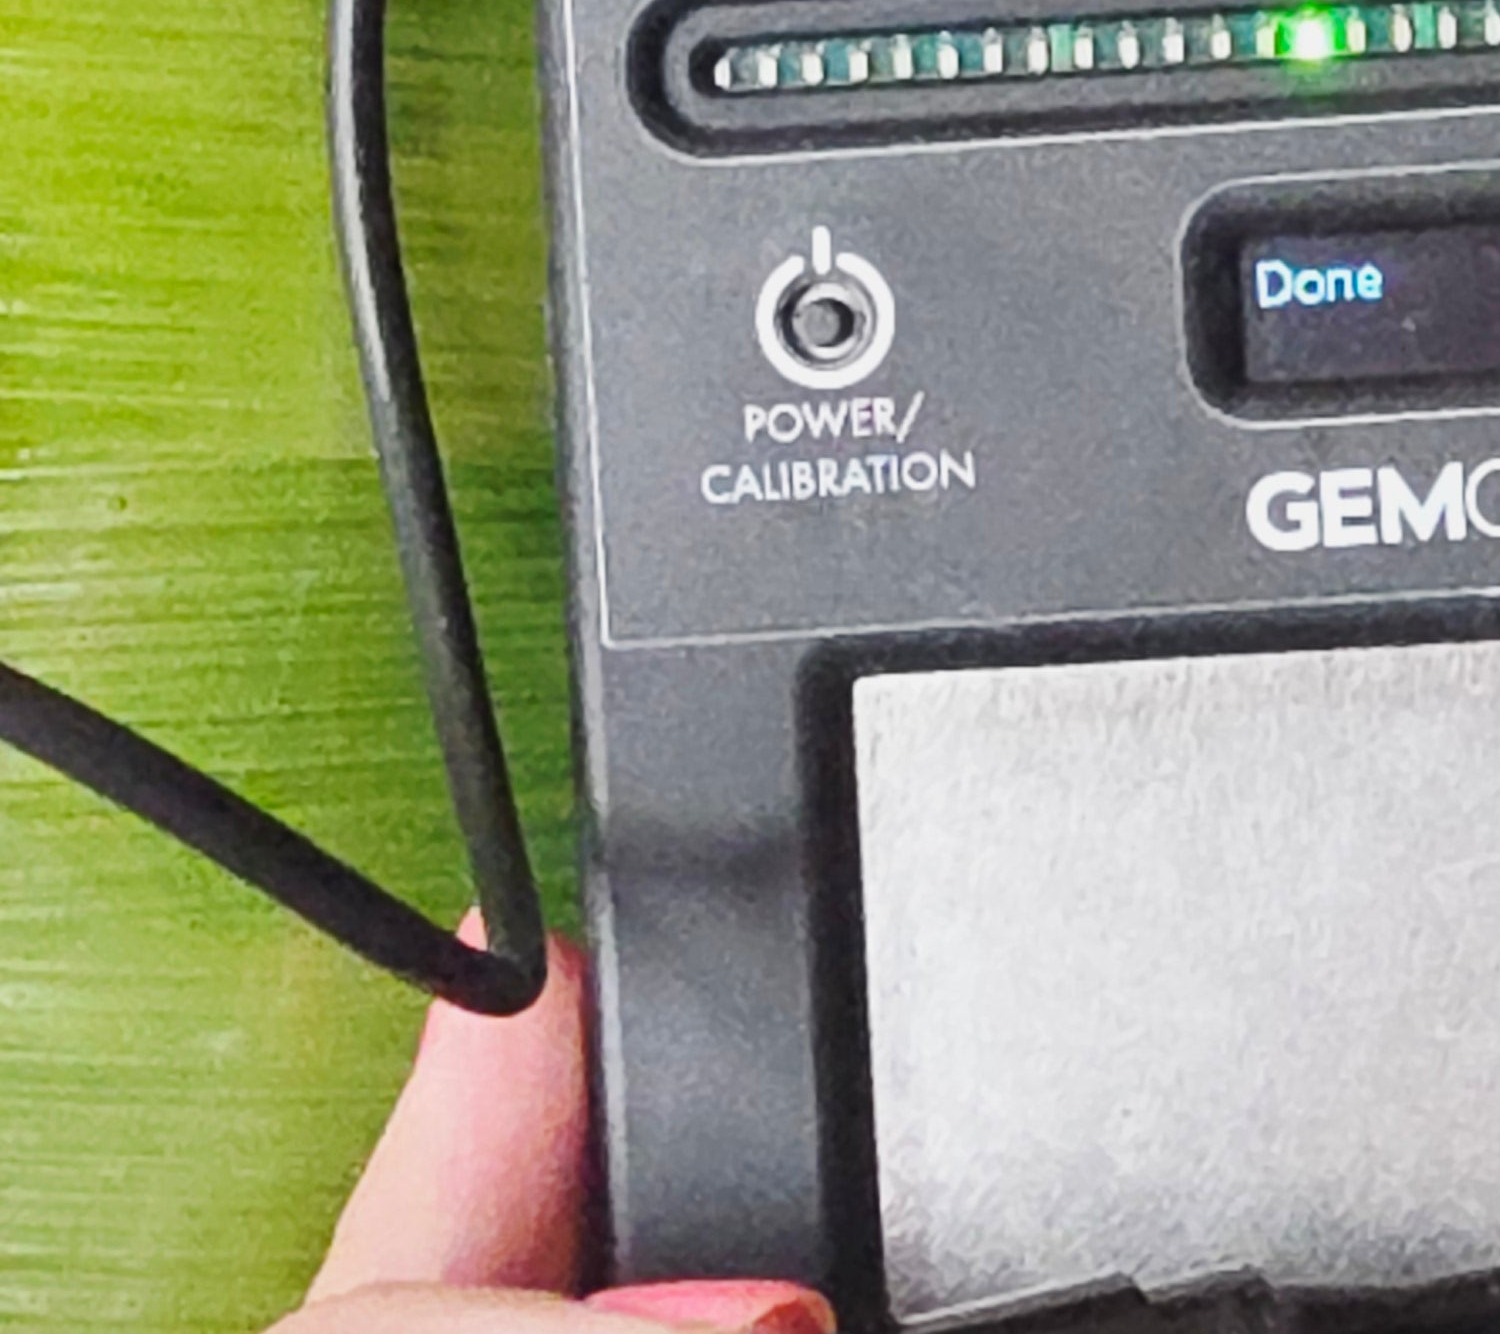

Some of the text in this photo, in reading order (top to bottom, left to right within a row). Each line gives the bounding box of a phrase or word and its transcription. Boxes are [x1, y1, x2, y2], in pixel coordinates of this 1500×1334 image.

[1255, 258, 1384, 309] Done
[743, 390, 925, 444] POWER/
[701, 449, 977, 505] CALIBRATION
